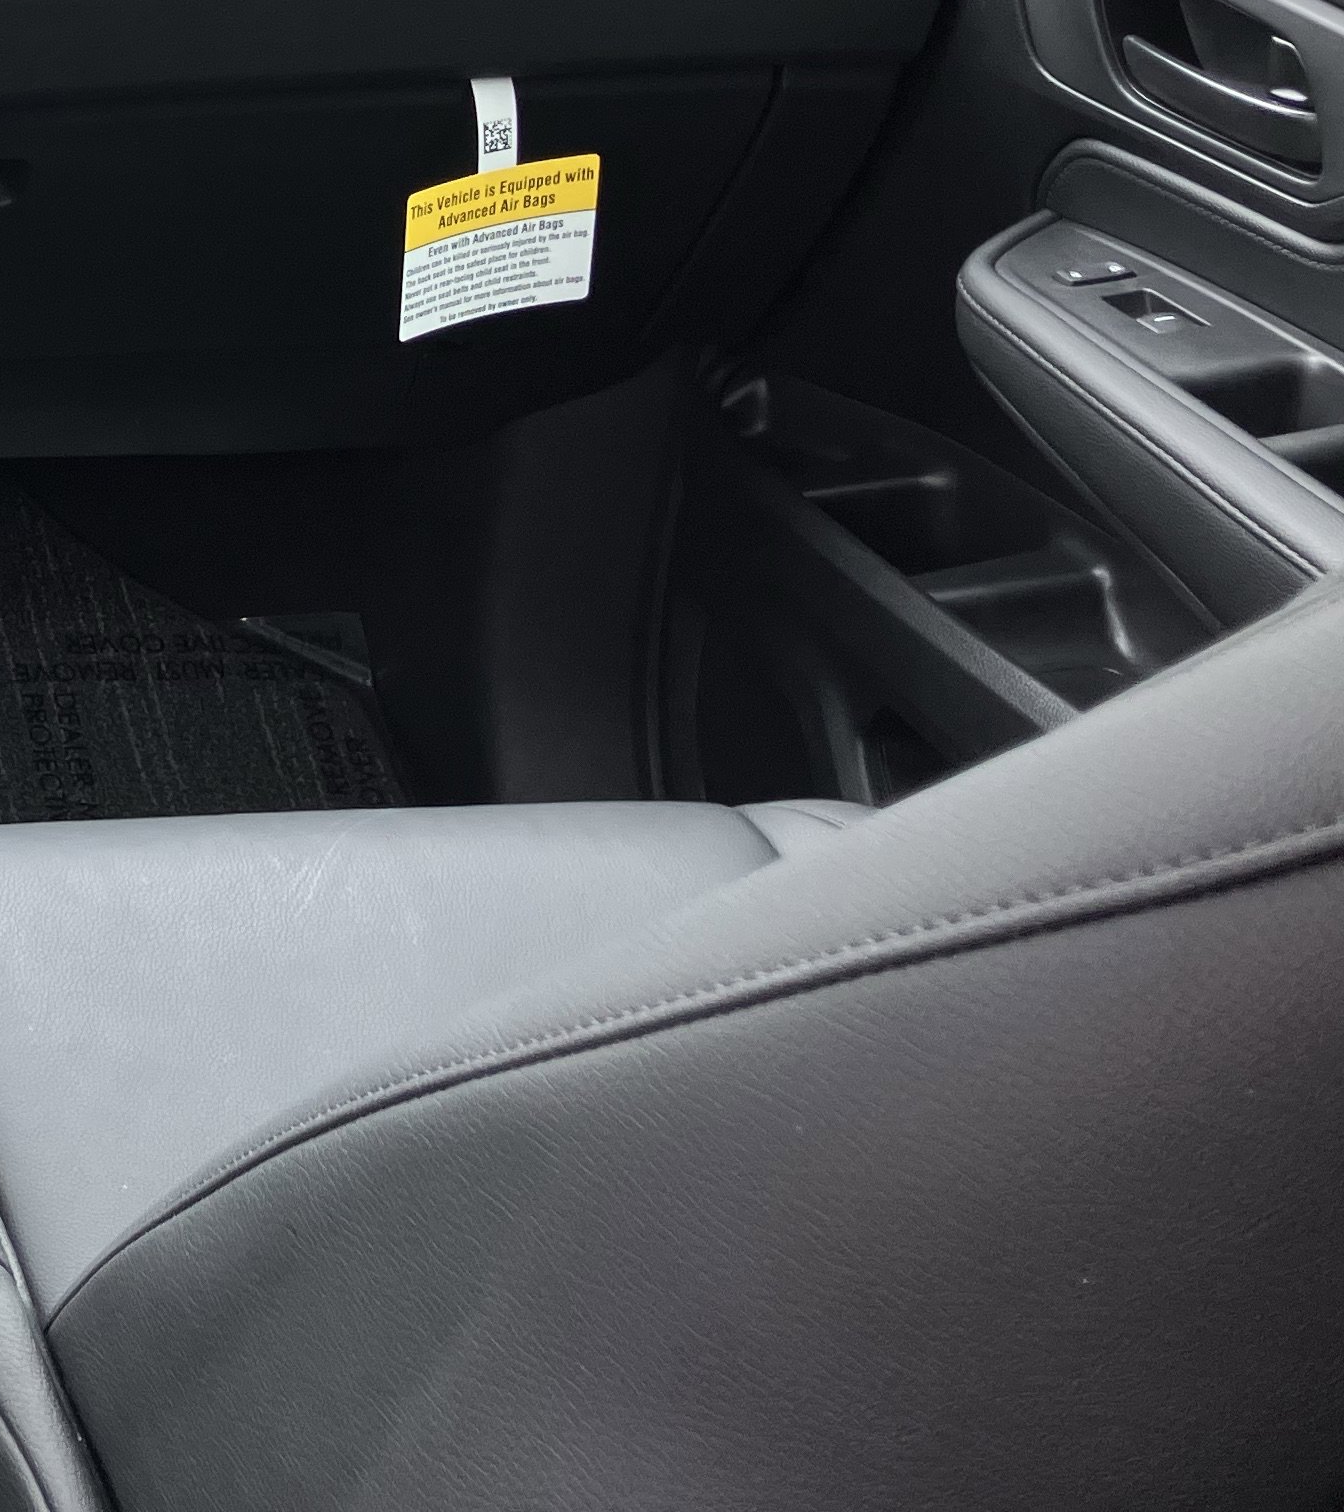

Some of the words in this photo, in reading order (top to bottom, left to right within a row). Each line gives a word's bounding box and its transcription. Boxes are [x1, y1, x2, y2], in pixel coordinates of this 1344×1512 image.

[411, 202, 433, 220] This
[437, 187, 480, 210] Vehicle
[485, 184, 495, 197] is
[500, 171, 561, 194] Equipped
[565, 167, 594, 182] with
[438, 202, 496, 229] Advanced
[500, 198, 519, 213] Air
[523, 193, 555, 209] Bags
[428, 243, 448, 258] Even
[451, 236, 470, 249] with
[473, 225, 519, 243] Advanced
[521, 223, 535, 234] Air
[539, 219, 564, 231] Bags
